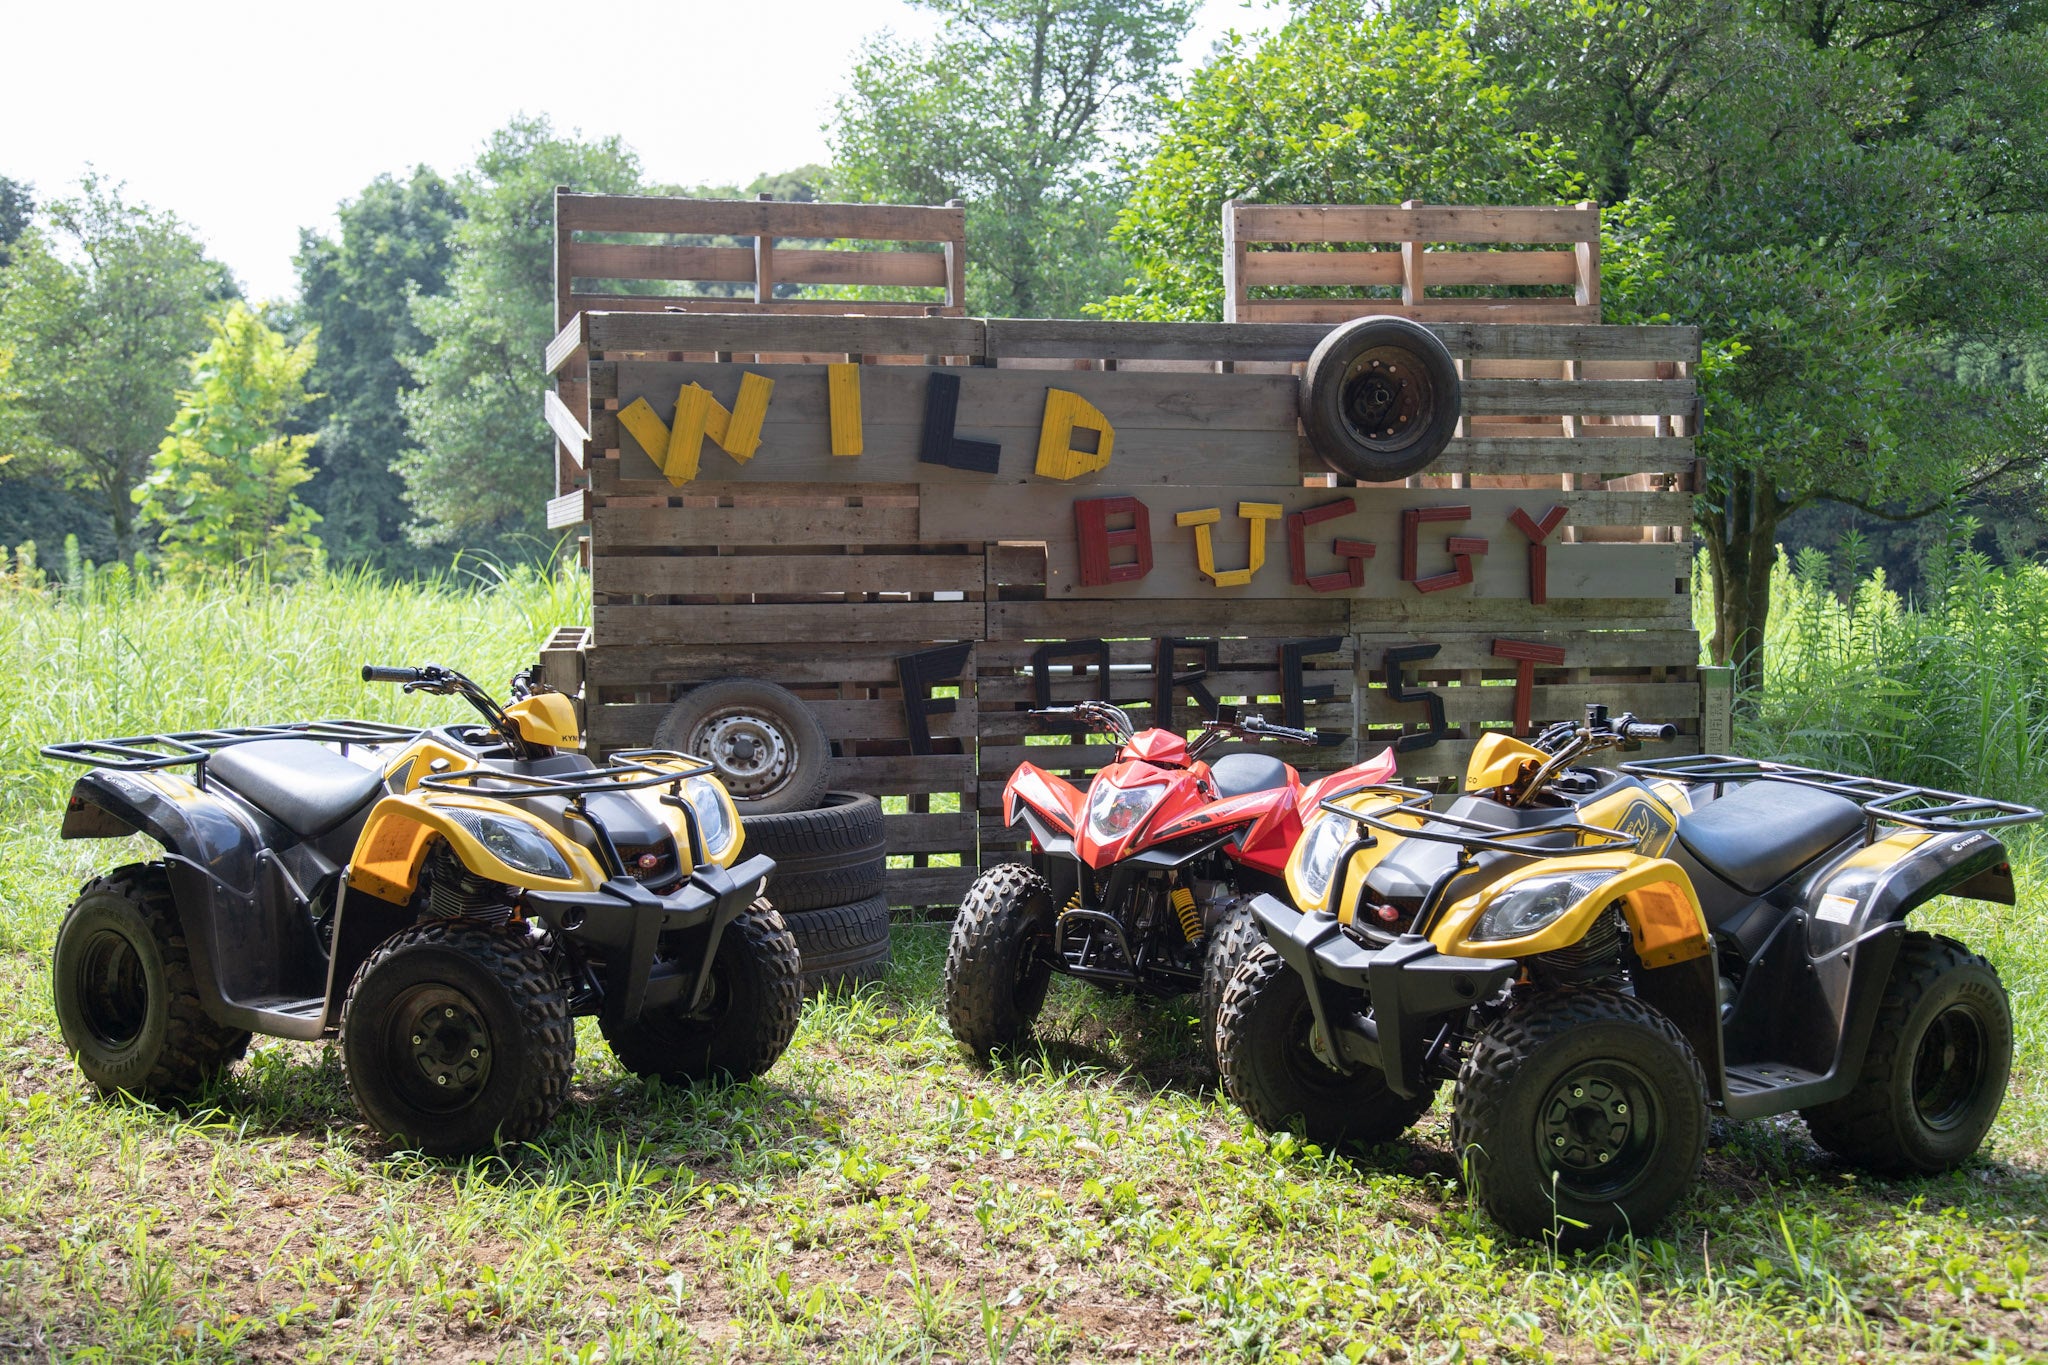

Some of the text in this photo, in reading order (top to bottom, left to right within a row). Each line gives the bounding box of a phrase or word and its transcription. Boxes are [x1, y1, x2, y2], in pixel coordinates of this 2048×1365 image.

[617, 363, 1116, 487] WILD
[1074, 497, 1569, 604] BUGGY
[896, 636, 1565, 754] FOREST
